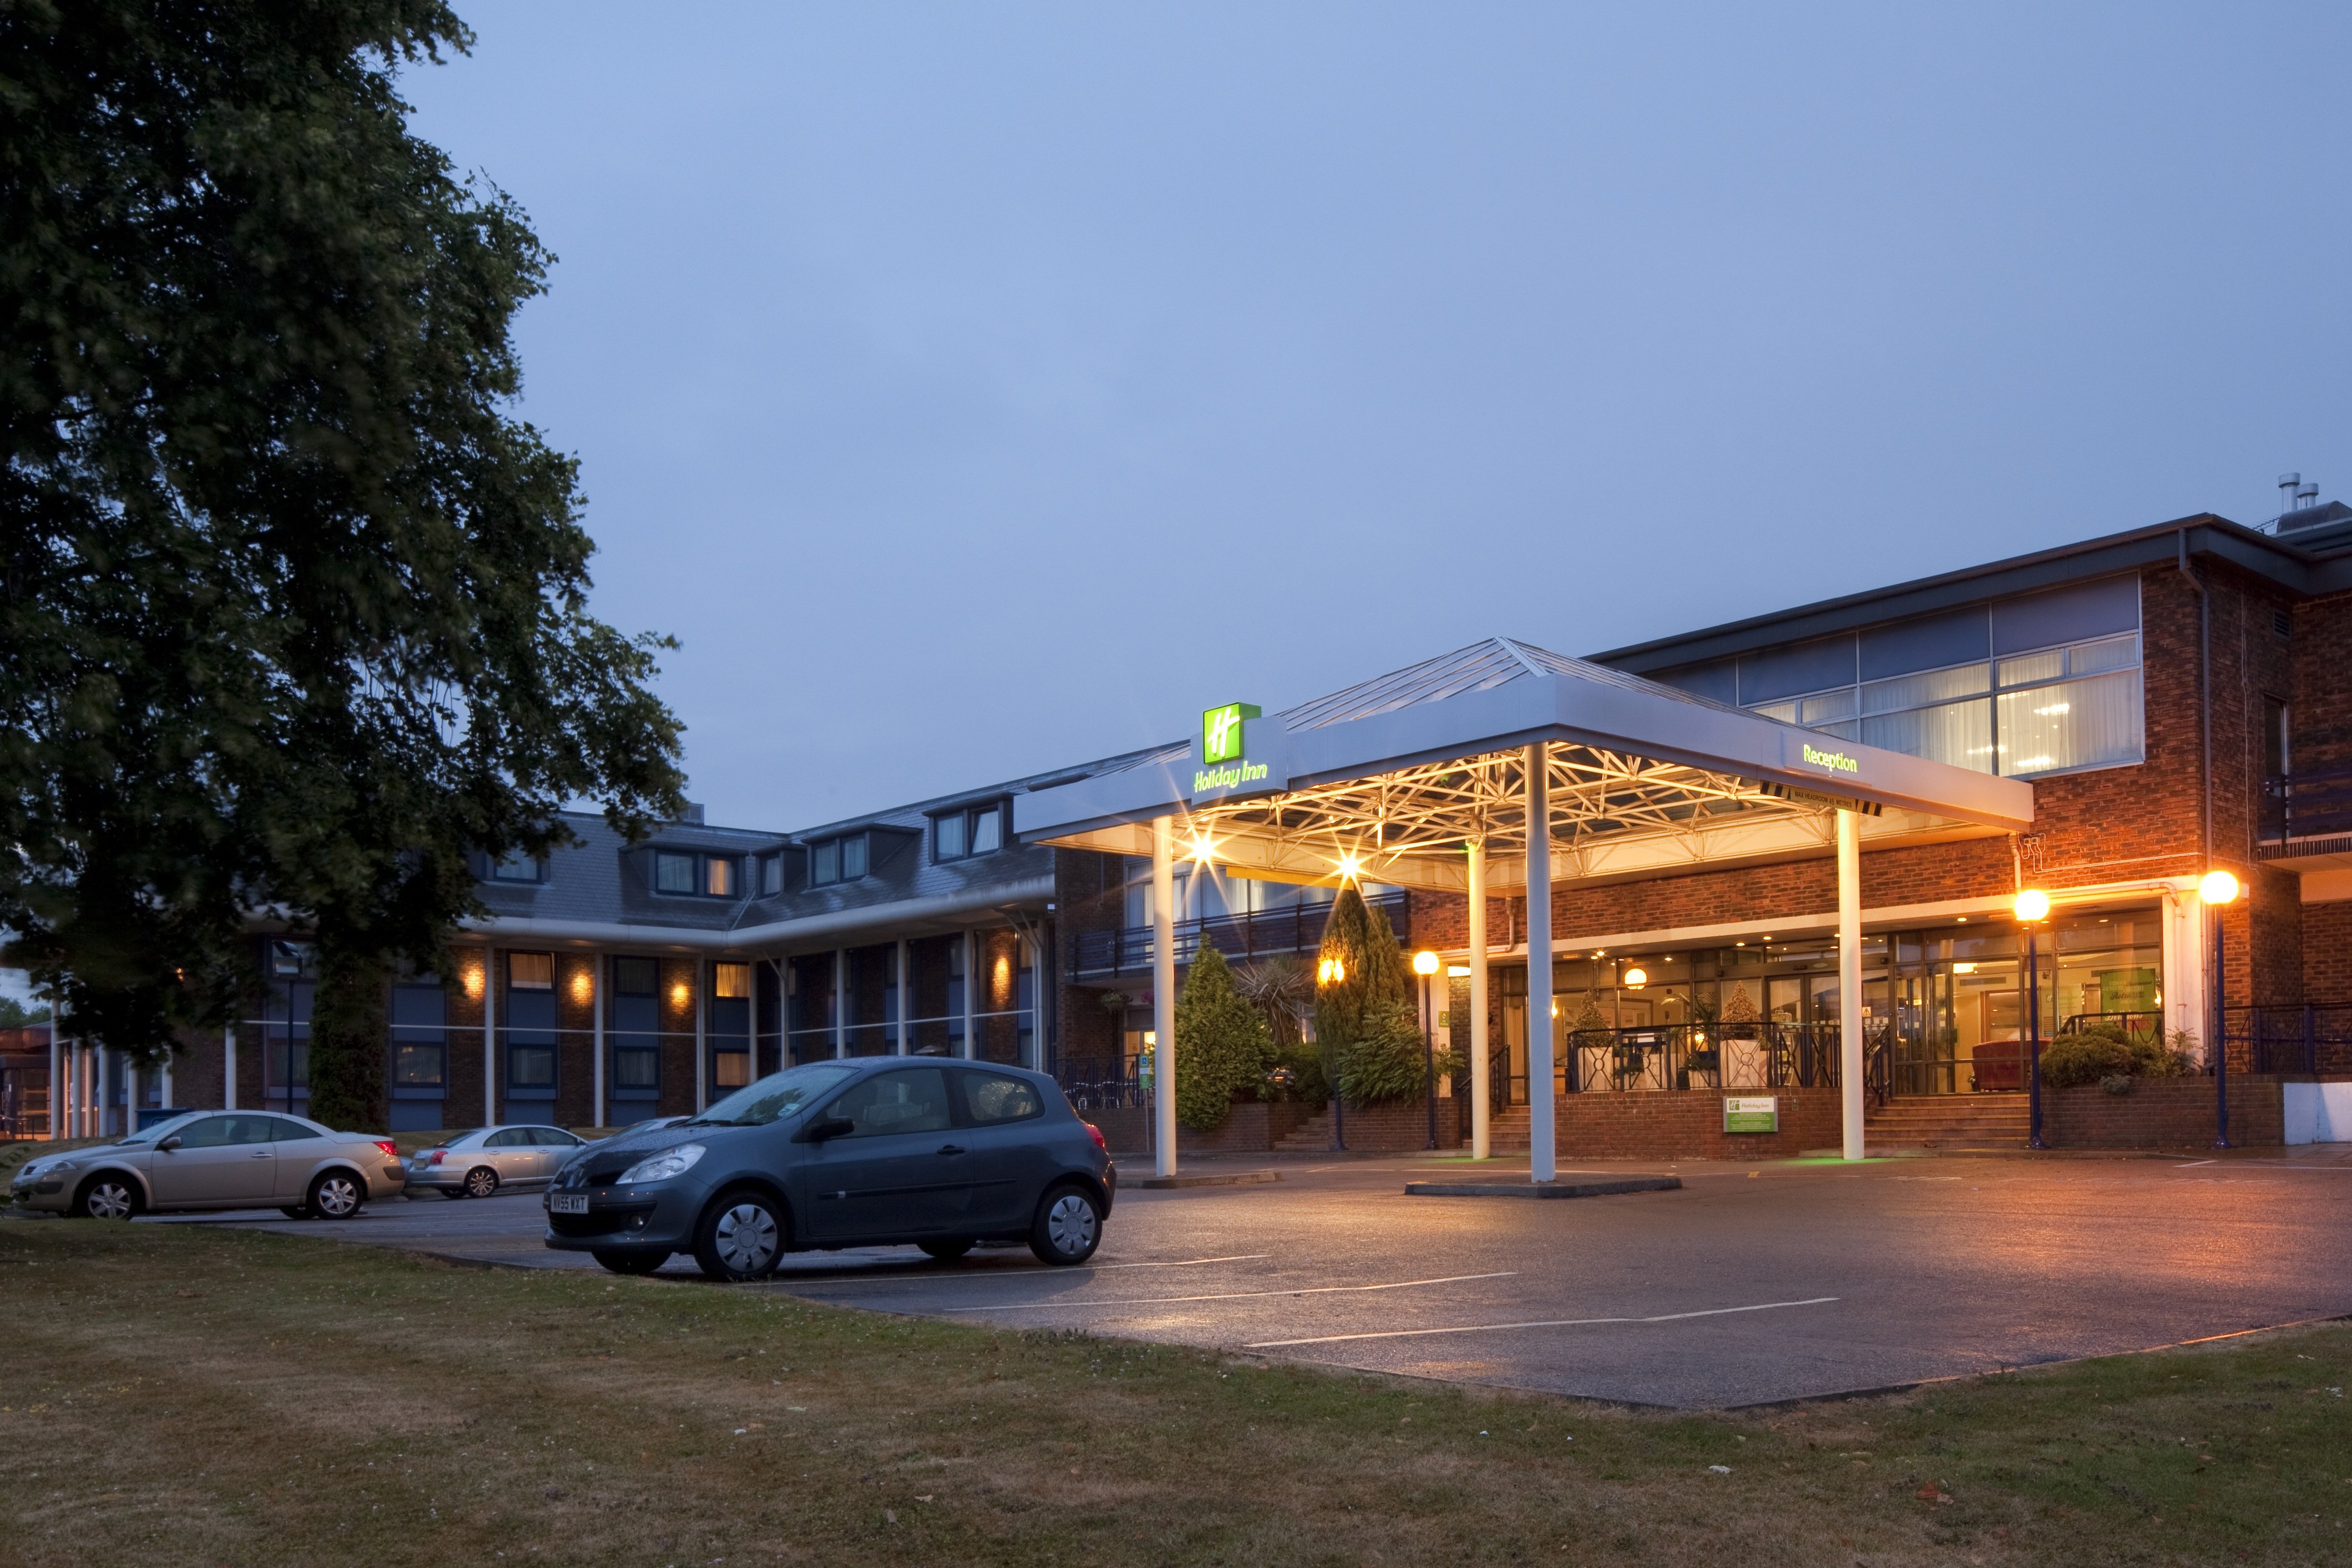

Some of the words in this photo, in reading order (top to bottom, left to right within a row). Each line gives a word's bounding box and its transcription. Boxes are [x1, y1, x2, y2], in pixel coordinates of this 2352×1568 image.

[1803, 744, 1857, 773] Reception
[1194, 766, 1240, 792] Holiday
[1241, 760, 1267, 781] Inn
[1804, 793, 1828, 803] HEADROOM
[1836, 799, 1852, 808] METRES
